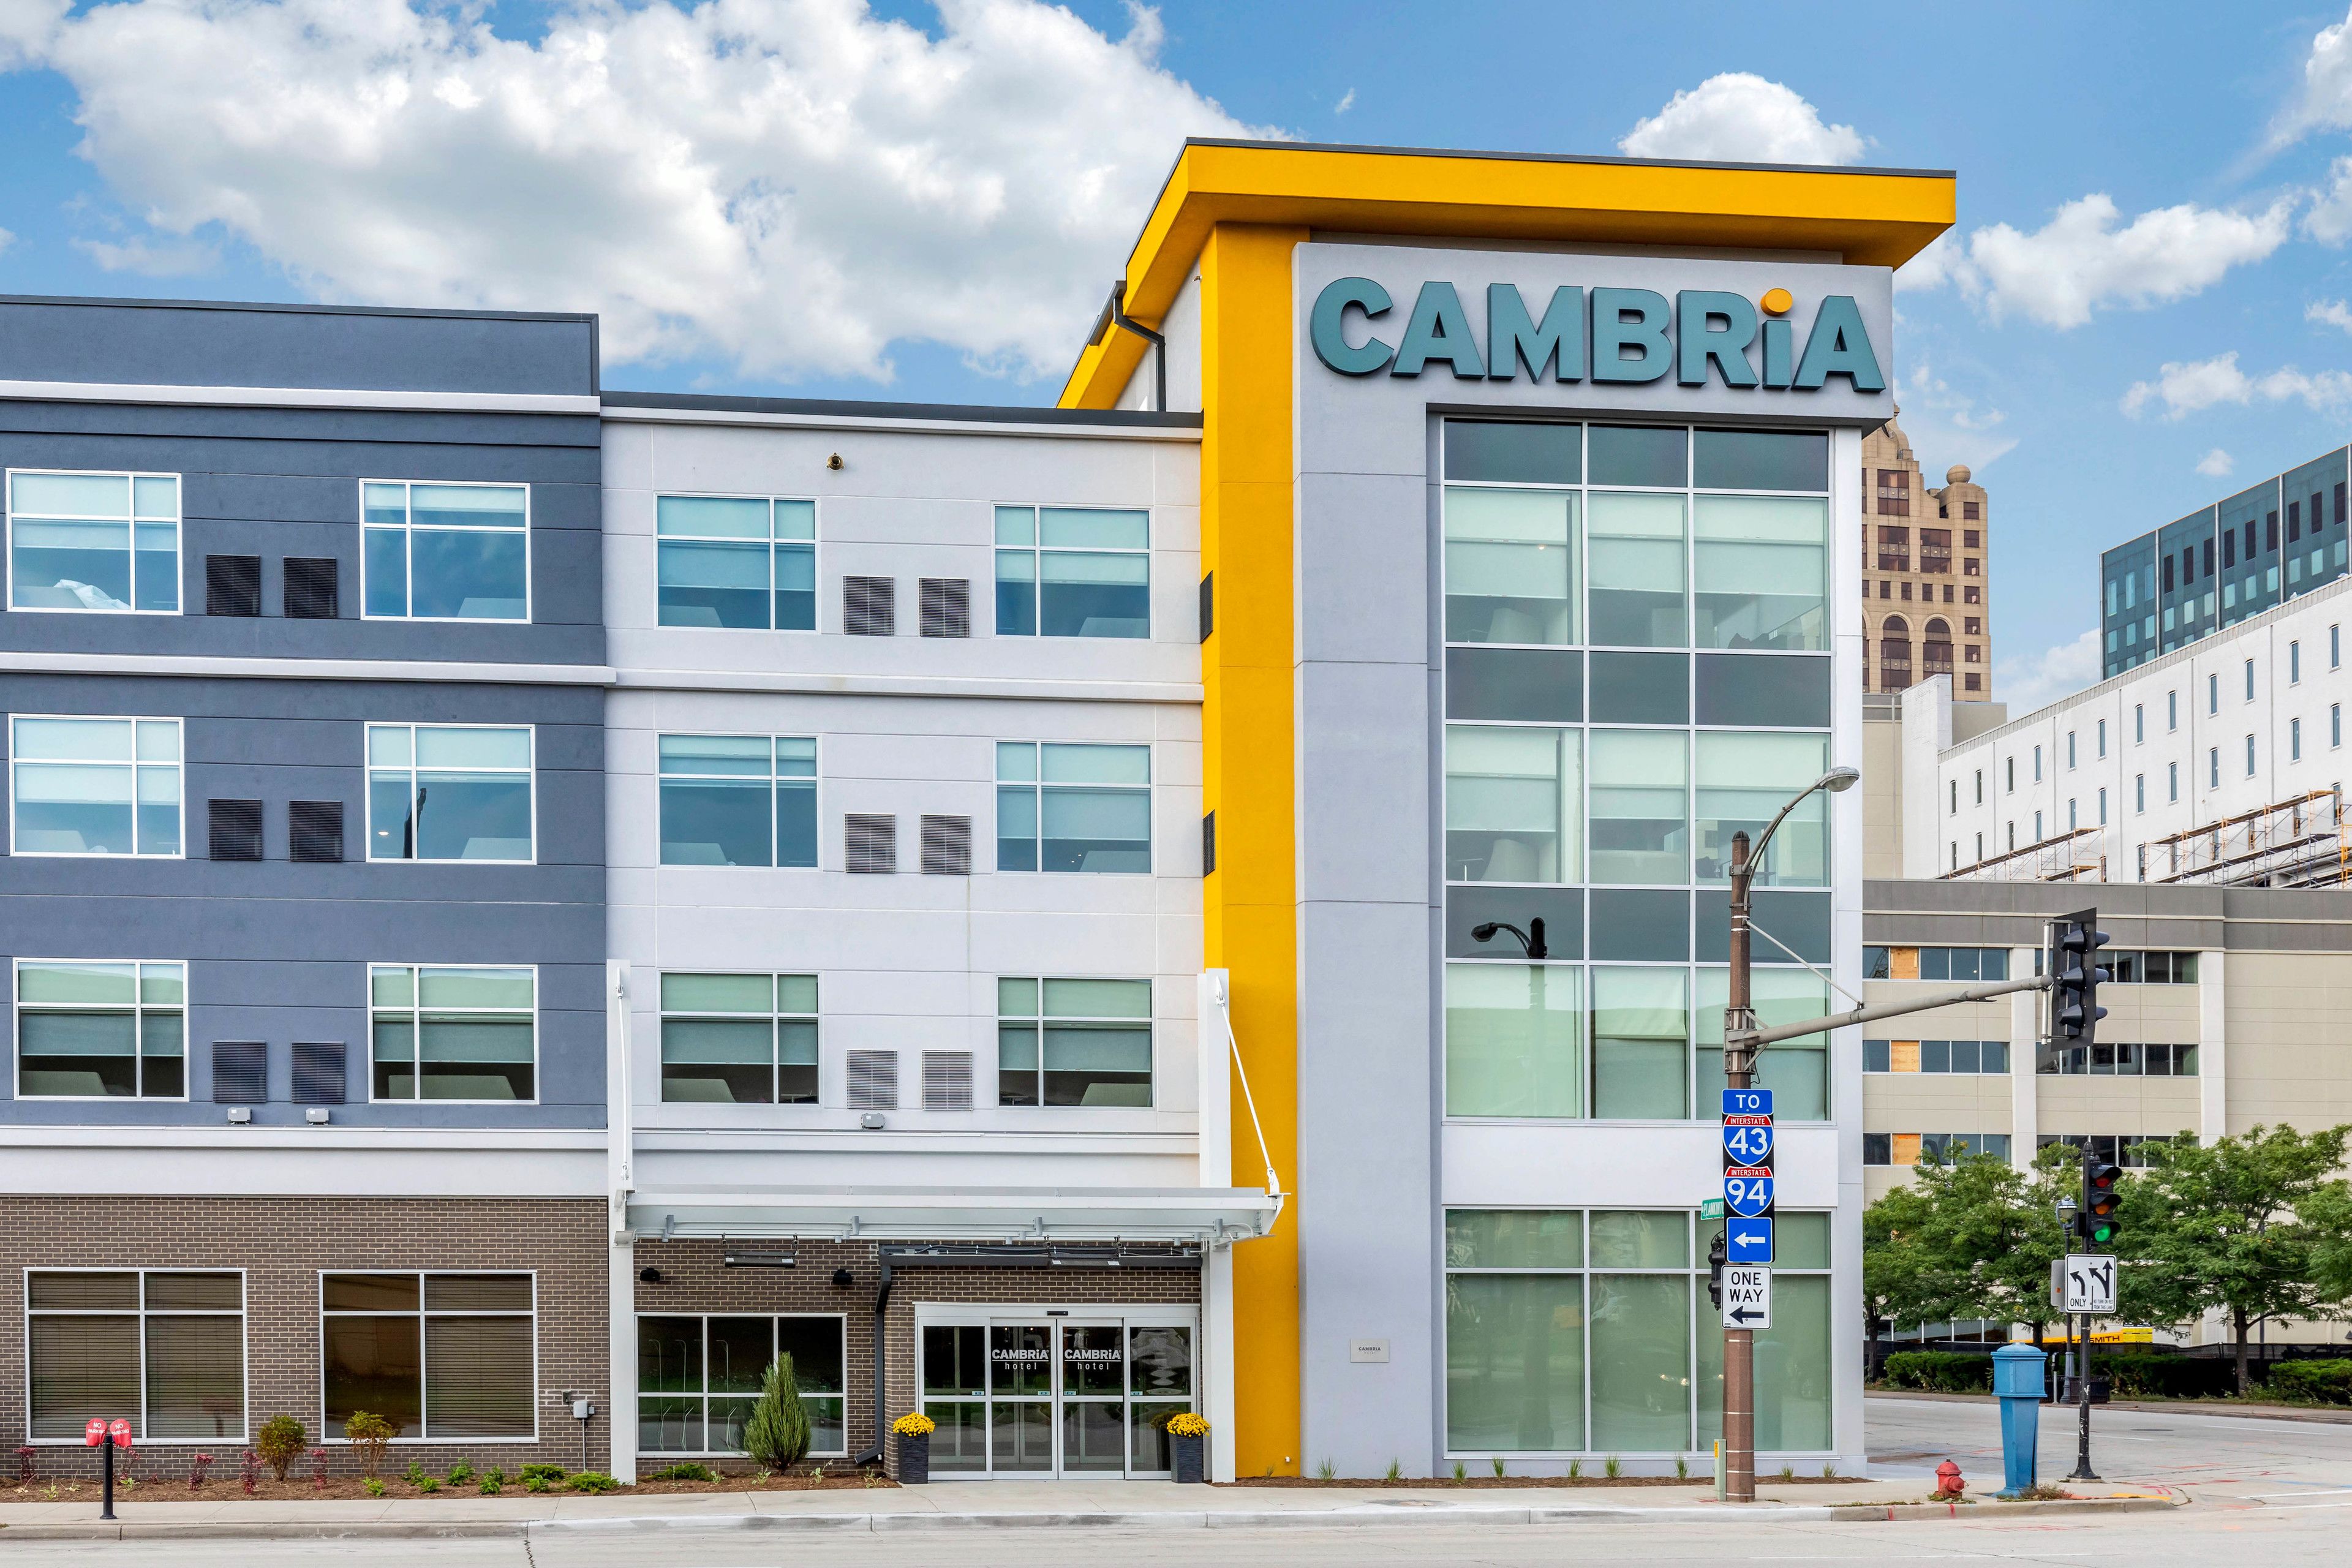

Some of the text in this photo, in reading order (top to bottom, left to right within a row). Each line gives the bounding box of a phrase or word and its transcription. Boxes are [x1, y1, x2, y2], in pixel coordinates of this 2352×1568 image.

[1735, 1095, 1760, 1109] TO
[1728, 1128, 1768, 1155] 43
[1727, 1179, 1766, 1206] 94
[1731, 1272, 1762, 1286] ONE
[1729, 1289, 1763, 1302] WAY
[2070, 1298, 2087, 1307] ONLY
